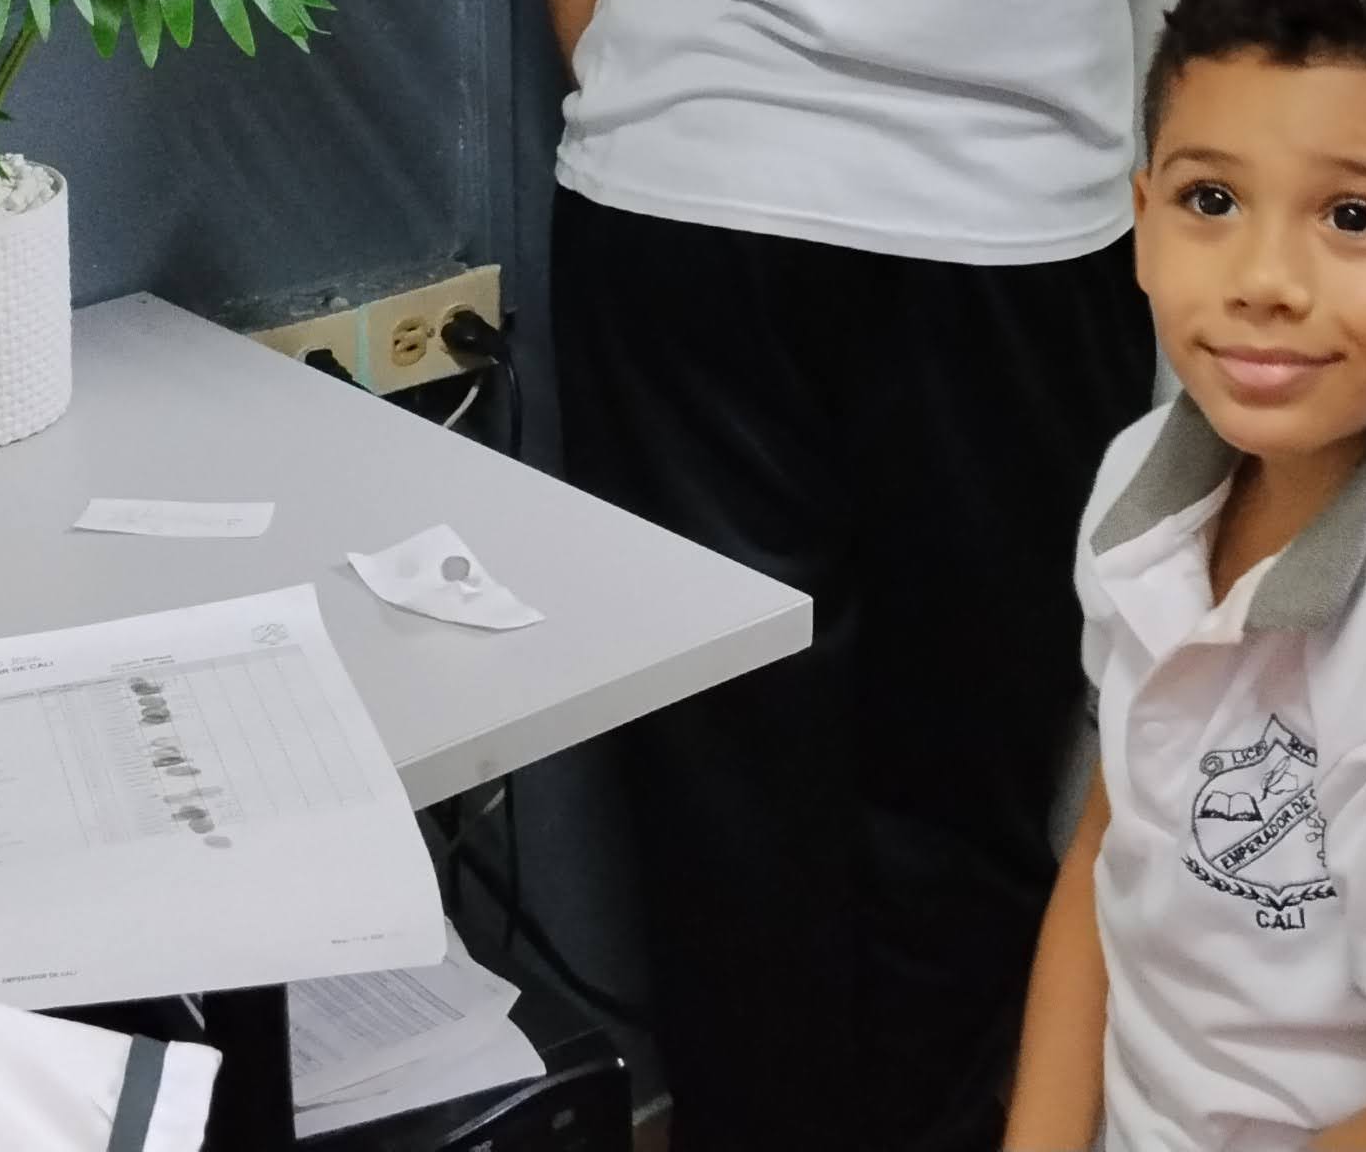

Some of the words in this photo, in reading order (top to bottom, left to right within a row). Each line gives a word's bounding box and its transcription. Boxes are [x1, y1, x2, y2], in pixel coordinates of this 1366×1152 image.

[1220, 809, 1292, 871] EMPERADOR
[1291, 794, 1313, 815] DE
[1255, 908, 1306, 932] CALI
